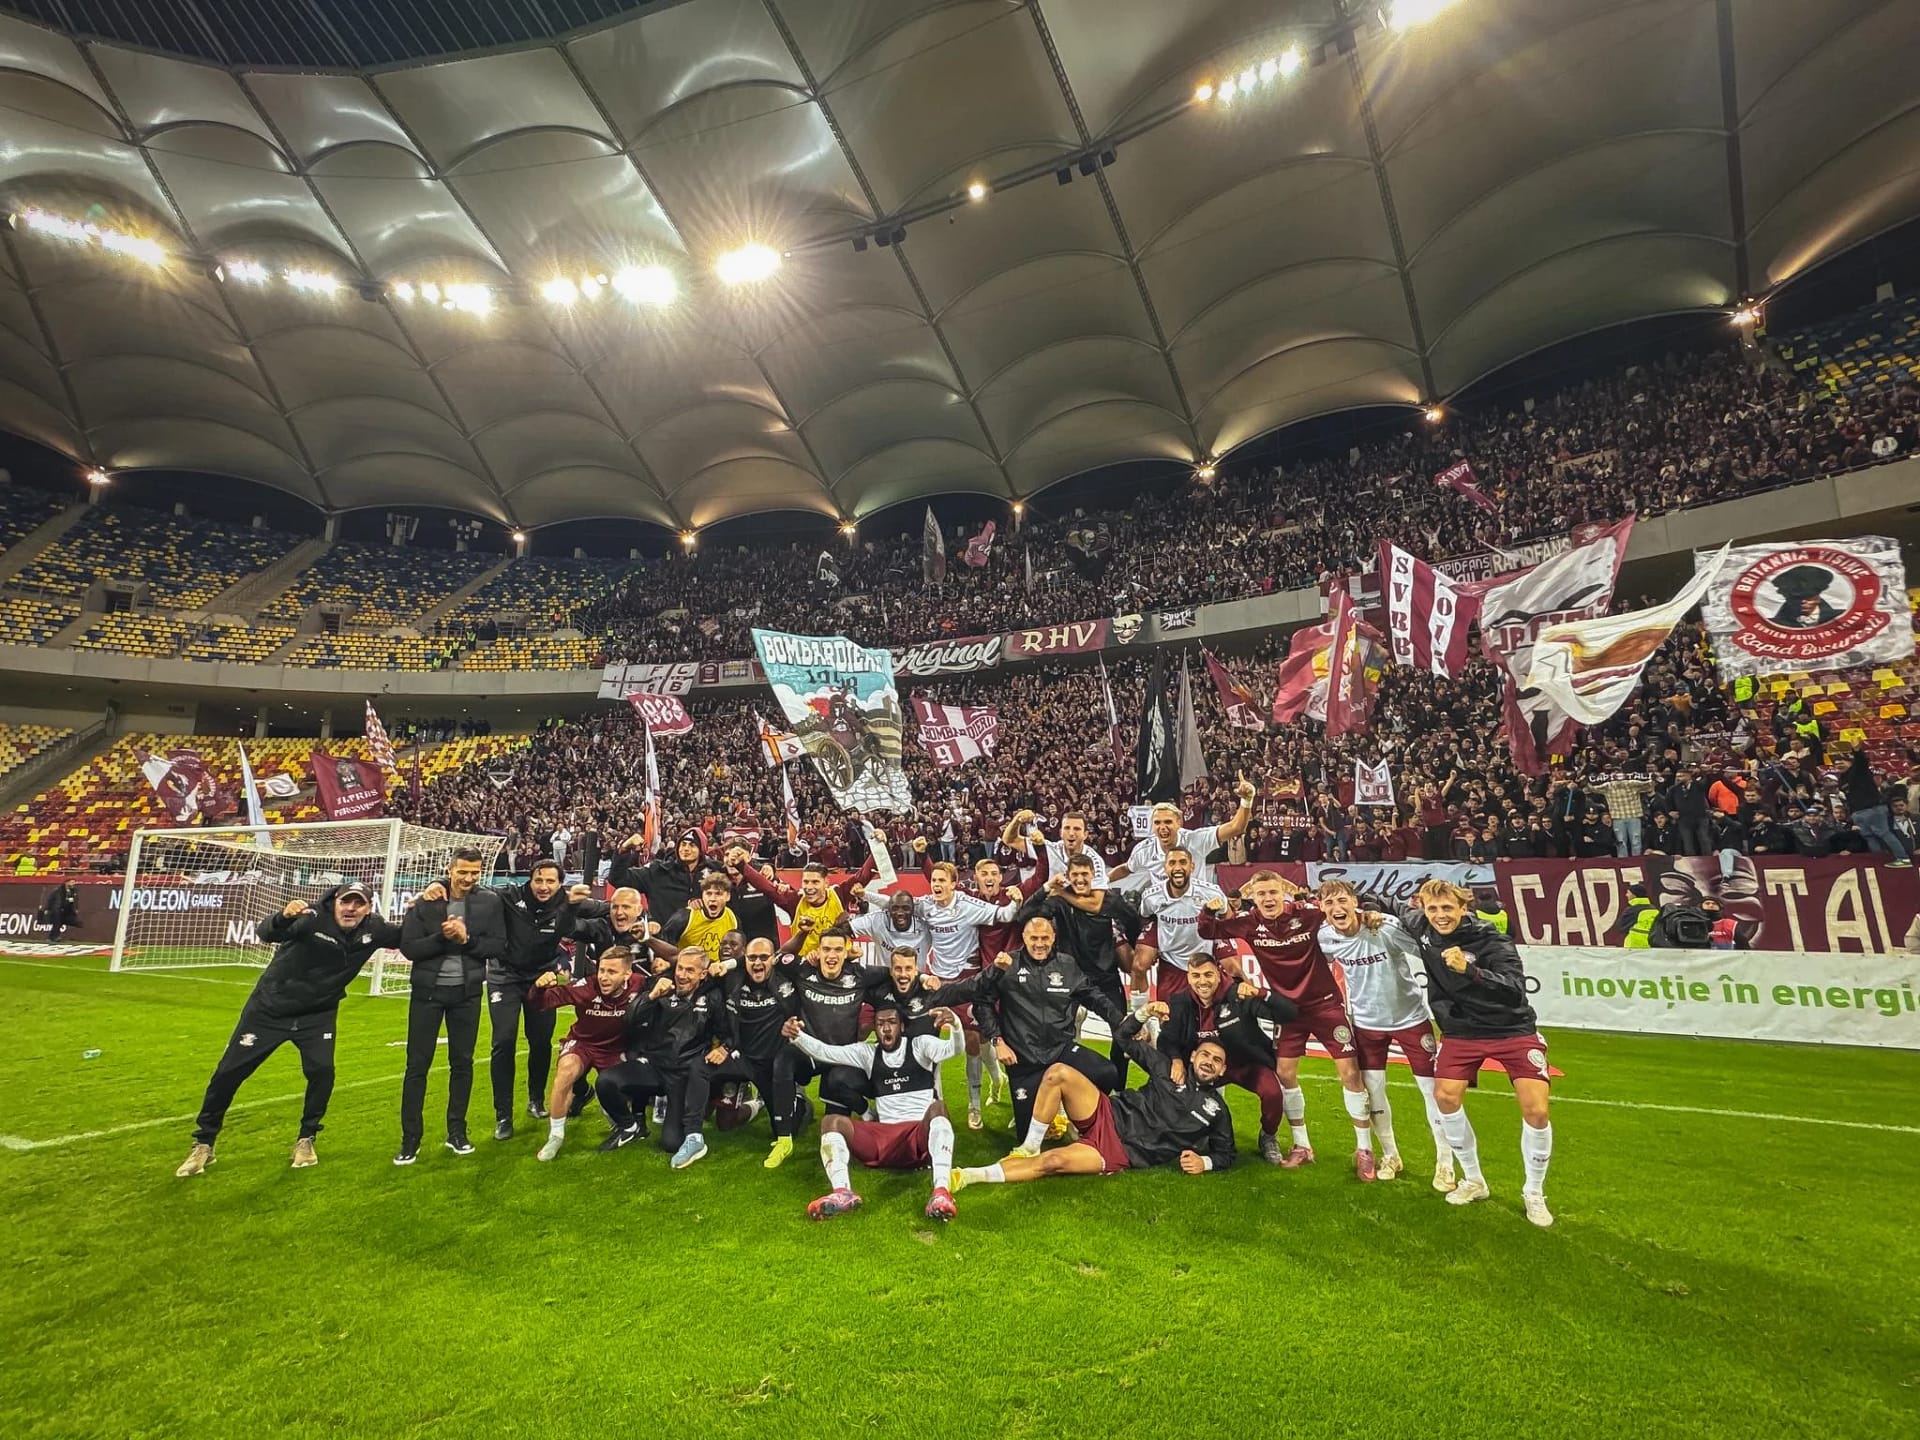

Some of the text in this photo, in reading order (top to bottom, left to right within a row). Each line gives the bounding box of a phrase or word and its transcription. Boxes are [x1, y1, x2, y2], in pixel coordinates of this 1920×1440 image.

[1737, 550, 1810, 592] BRITANNIA
[1020, 622, 1097, 652] RHV
[1738, 632, 1795, 656] Rapid
[1136, 817, 1148, 829] 90
[109, 889, 224, 911] NPOLEON GAMES
[1511, 867, 1644, 948] CAP
[928, 925, 959, 934] PERBET
[804, 989, 857, 1005] SUPERBET
[1562, 971, 1710, 1009] inovație
[1718, 974, 1760, 1004] în
[1771, 983, 1920, 1016] energi
[585, 1009, 626, 1017] MOBEXP
[884, 1076, 910, 1085] CATAPULT
